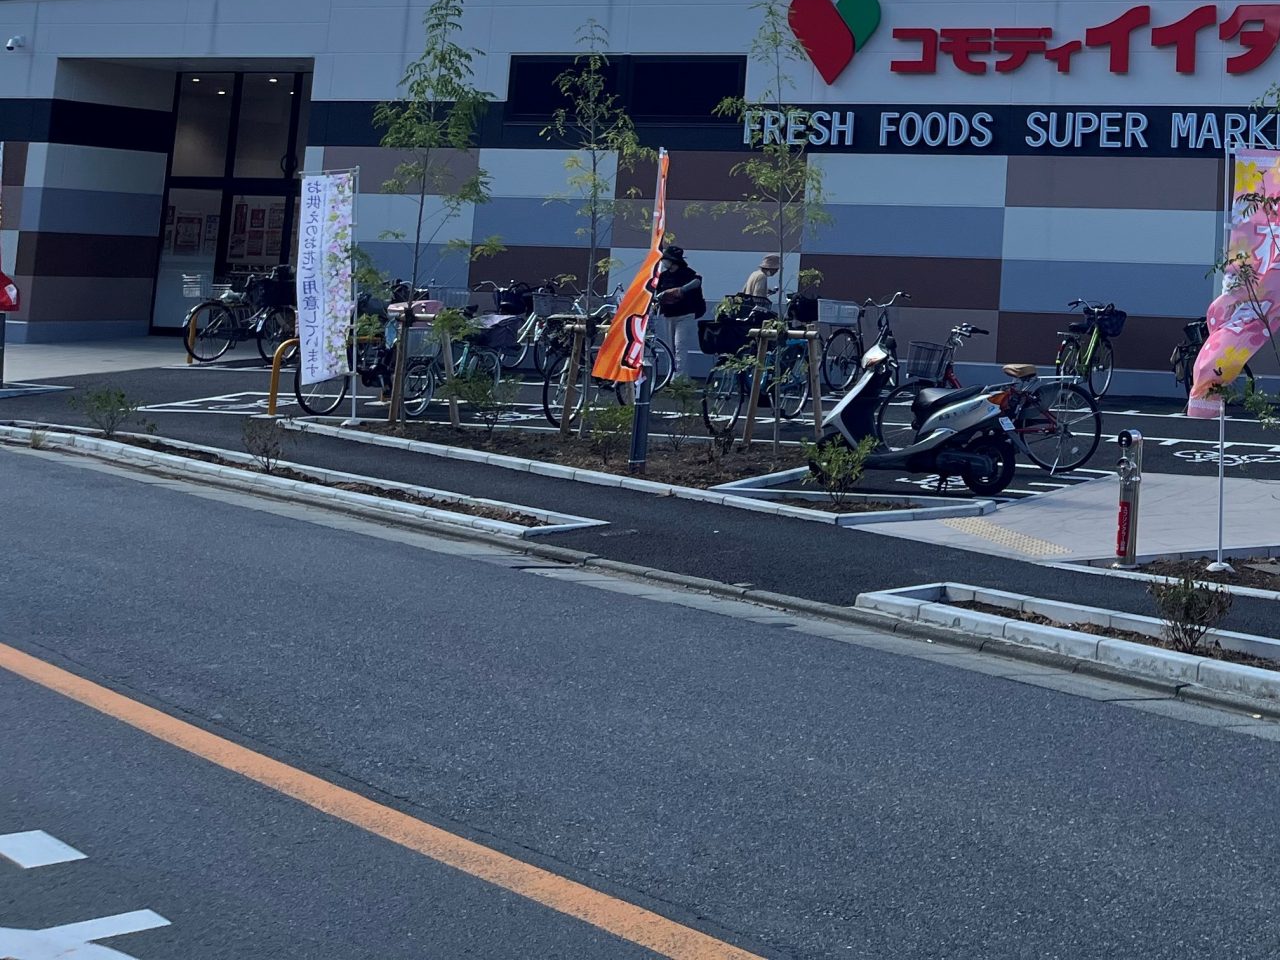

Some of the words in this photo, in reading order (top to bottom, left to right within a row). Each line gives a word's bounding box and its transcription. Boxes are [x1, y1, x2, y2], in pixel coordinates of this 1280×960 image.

[744, 110, 855, 146] FRESH
[879, 111, 994, 147] FOODS
[1025, 111, 1148, 148] SUPER
